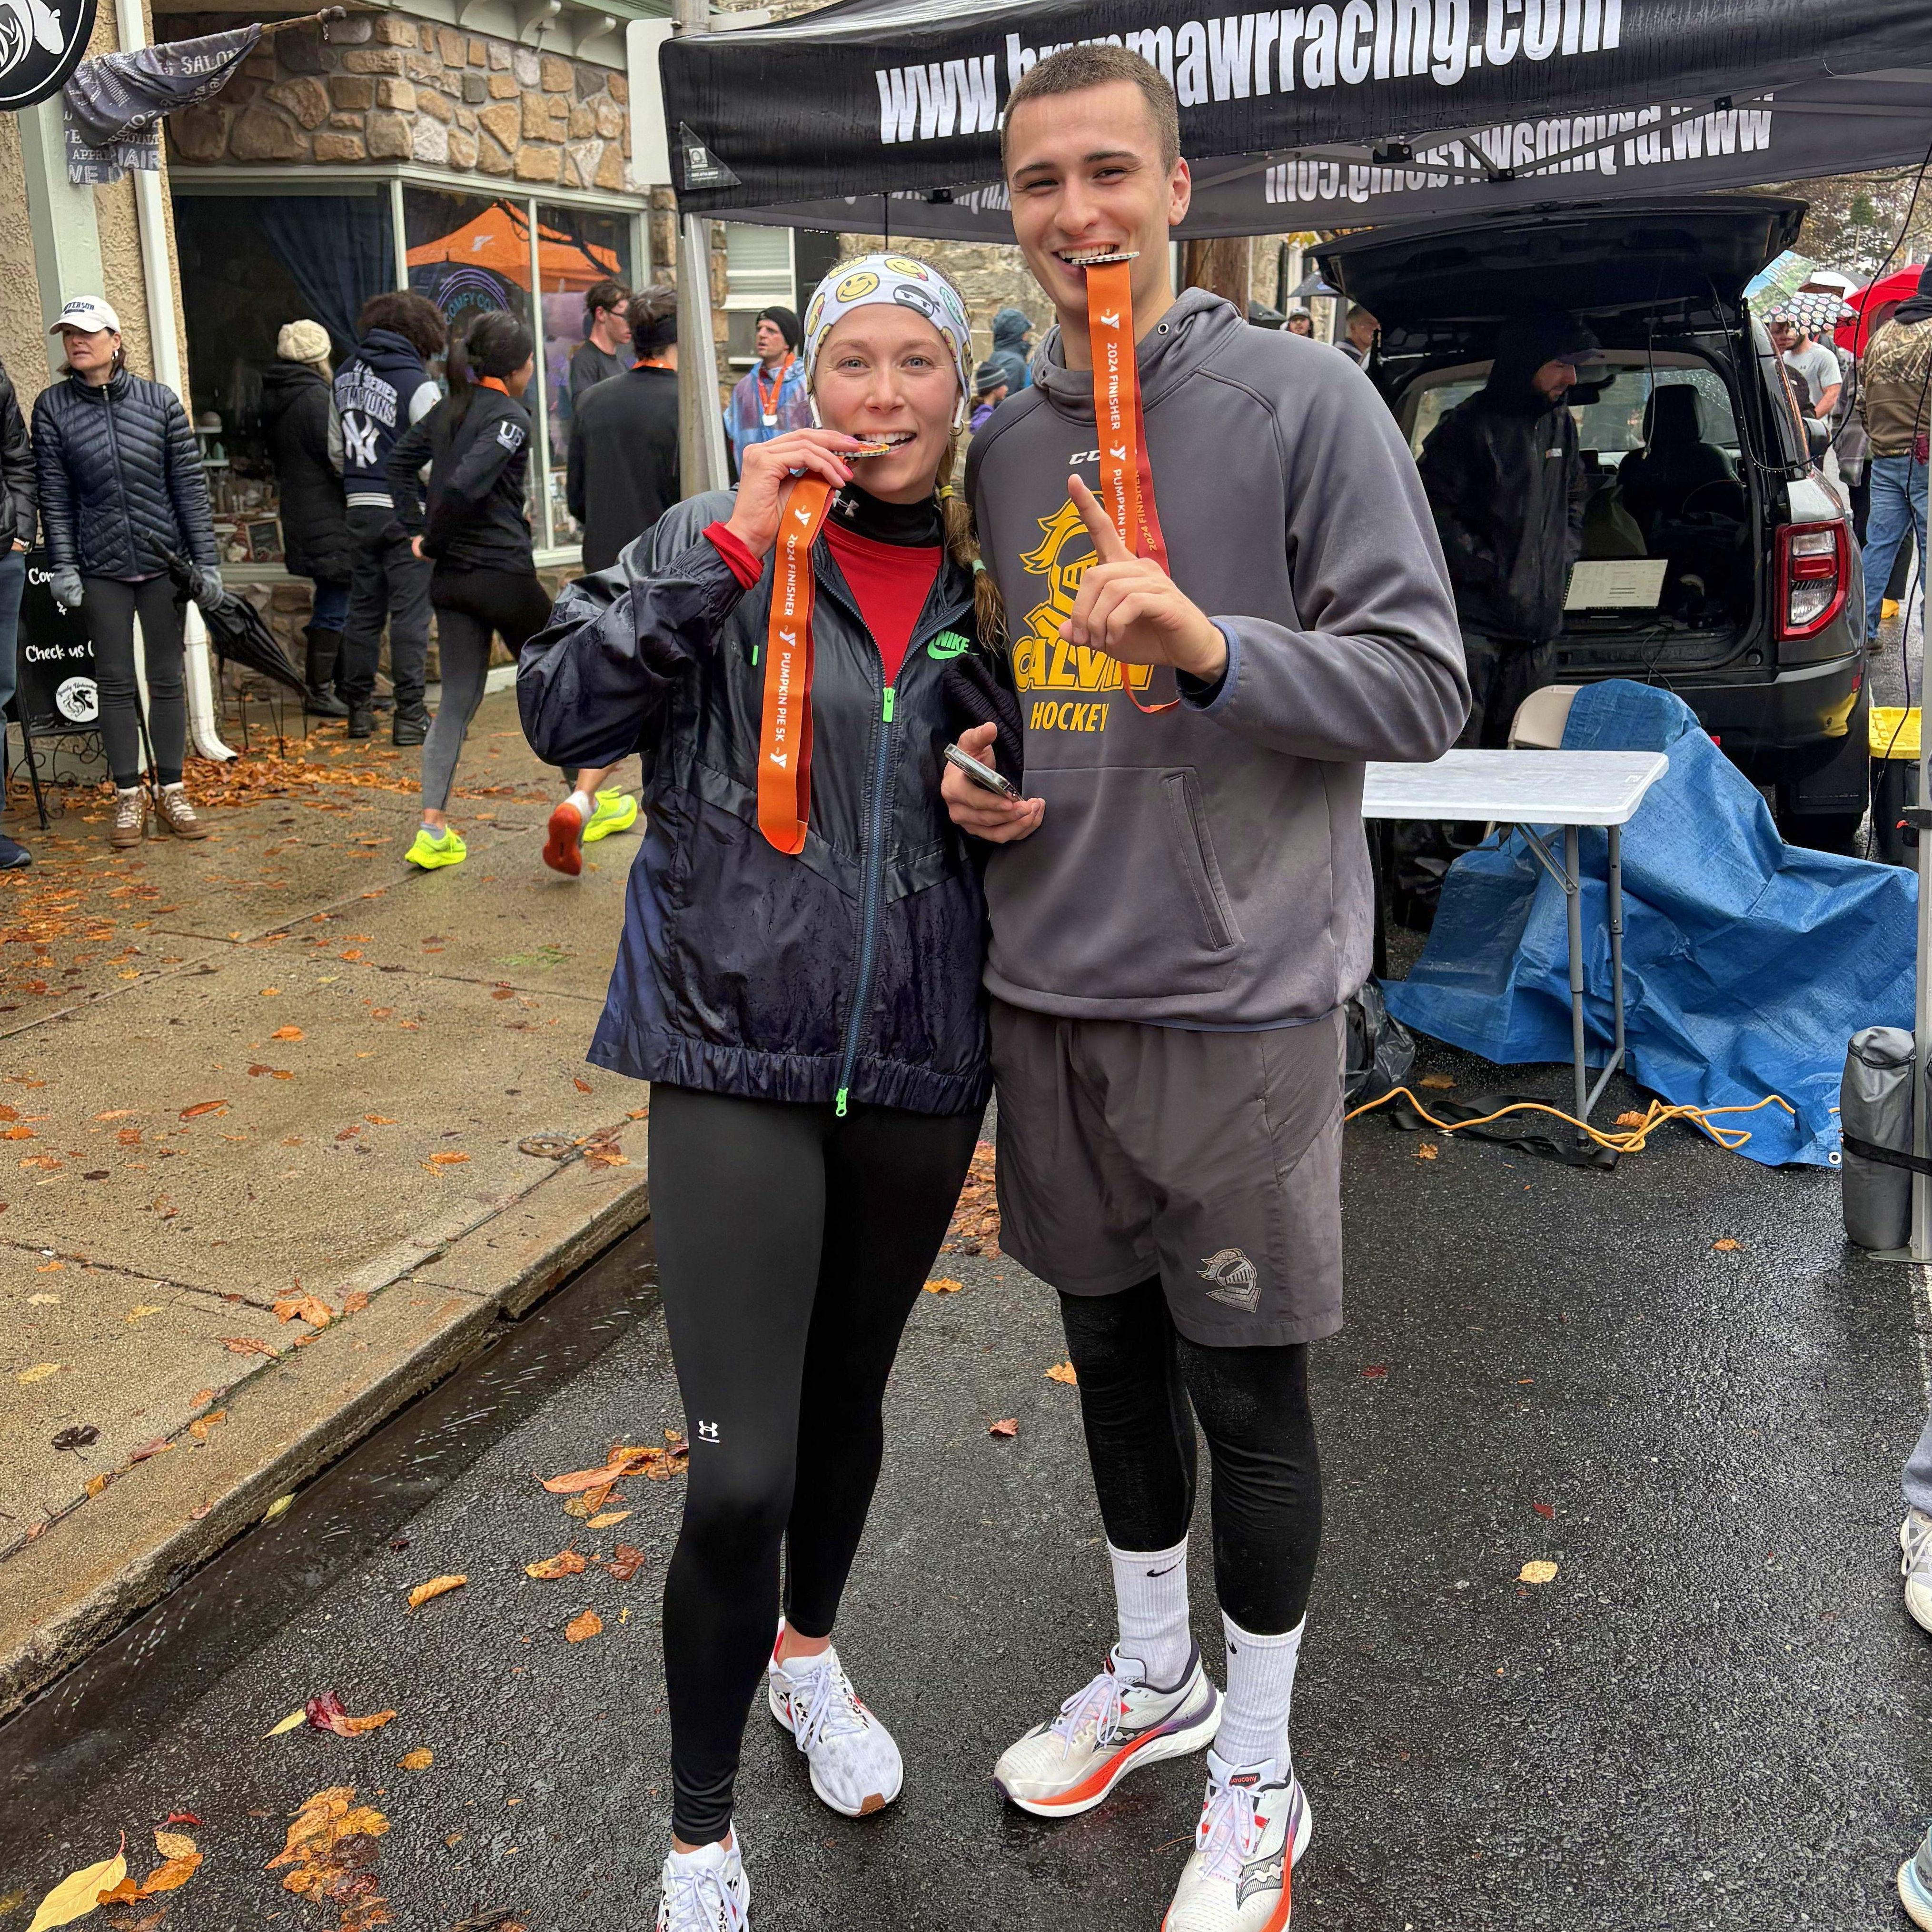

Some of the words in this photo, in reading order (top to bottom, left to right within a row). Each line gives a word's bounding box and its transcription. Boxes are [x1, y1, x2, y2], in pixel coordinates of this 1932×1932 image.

[1107, 342, 1118, 373] 2024
[1108, 375, 1121, 430] FINISHER
[1113, 468, 1126, 526] PUMPKIN
[787, 534, 799, 561] 2024
[1141, 525, 1157, 551] 2024
[783, 564, 796, 616] FINISHER
[25, 644, 66, 662] Check
[68, 644, 85, 658] us
[935, 631, 971, 652] NIKE
[778, 652, 791, 704] PUMPKIN
[777, 707, 787, 726] PIE
[1030, 701, 1109, 732] HOCKEY
[774, 727, 786, 742] 5K
